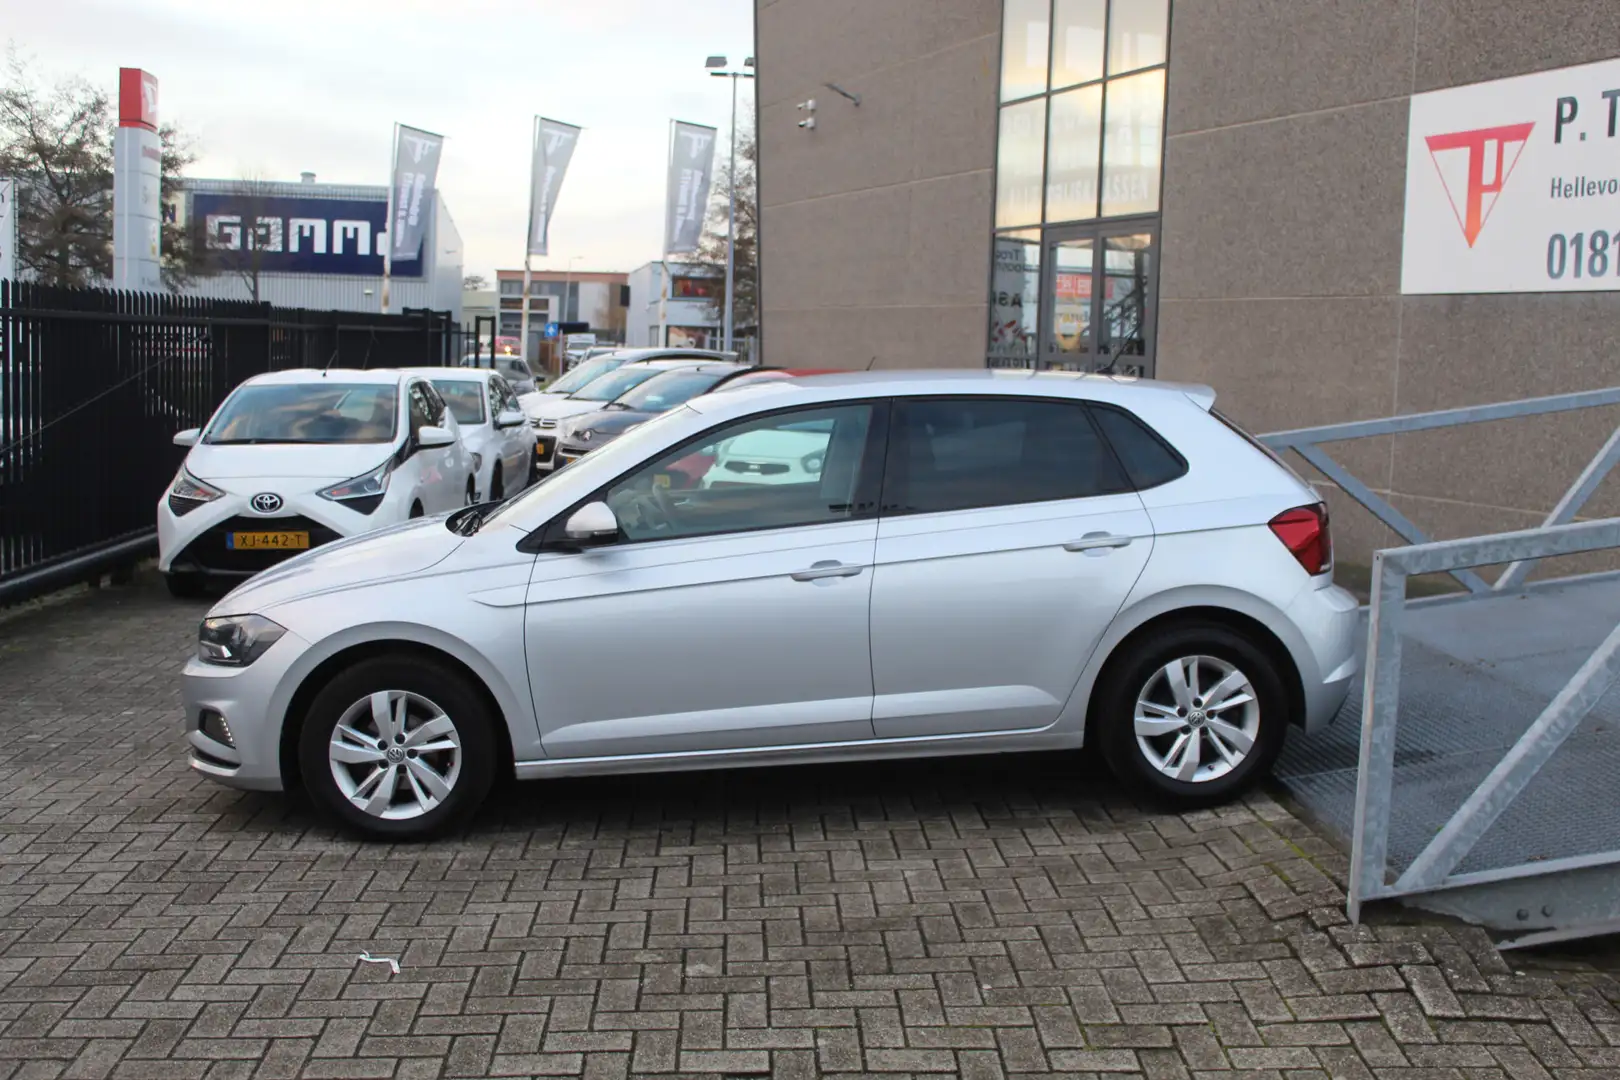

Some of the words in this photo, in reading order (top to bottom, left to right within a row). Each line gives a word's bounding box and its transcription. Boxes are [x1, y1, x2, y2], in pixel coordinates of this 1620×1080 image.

[1554, 96, 1586, 144] P.
[1550, 176, 1620, 199] Hellevo
[240, 534, 304, 547] XJ-442-T
